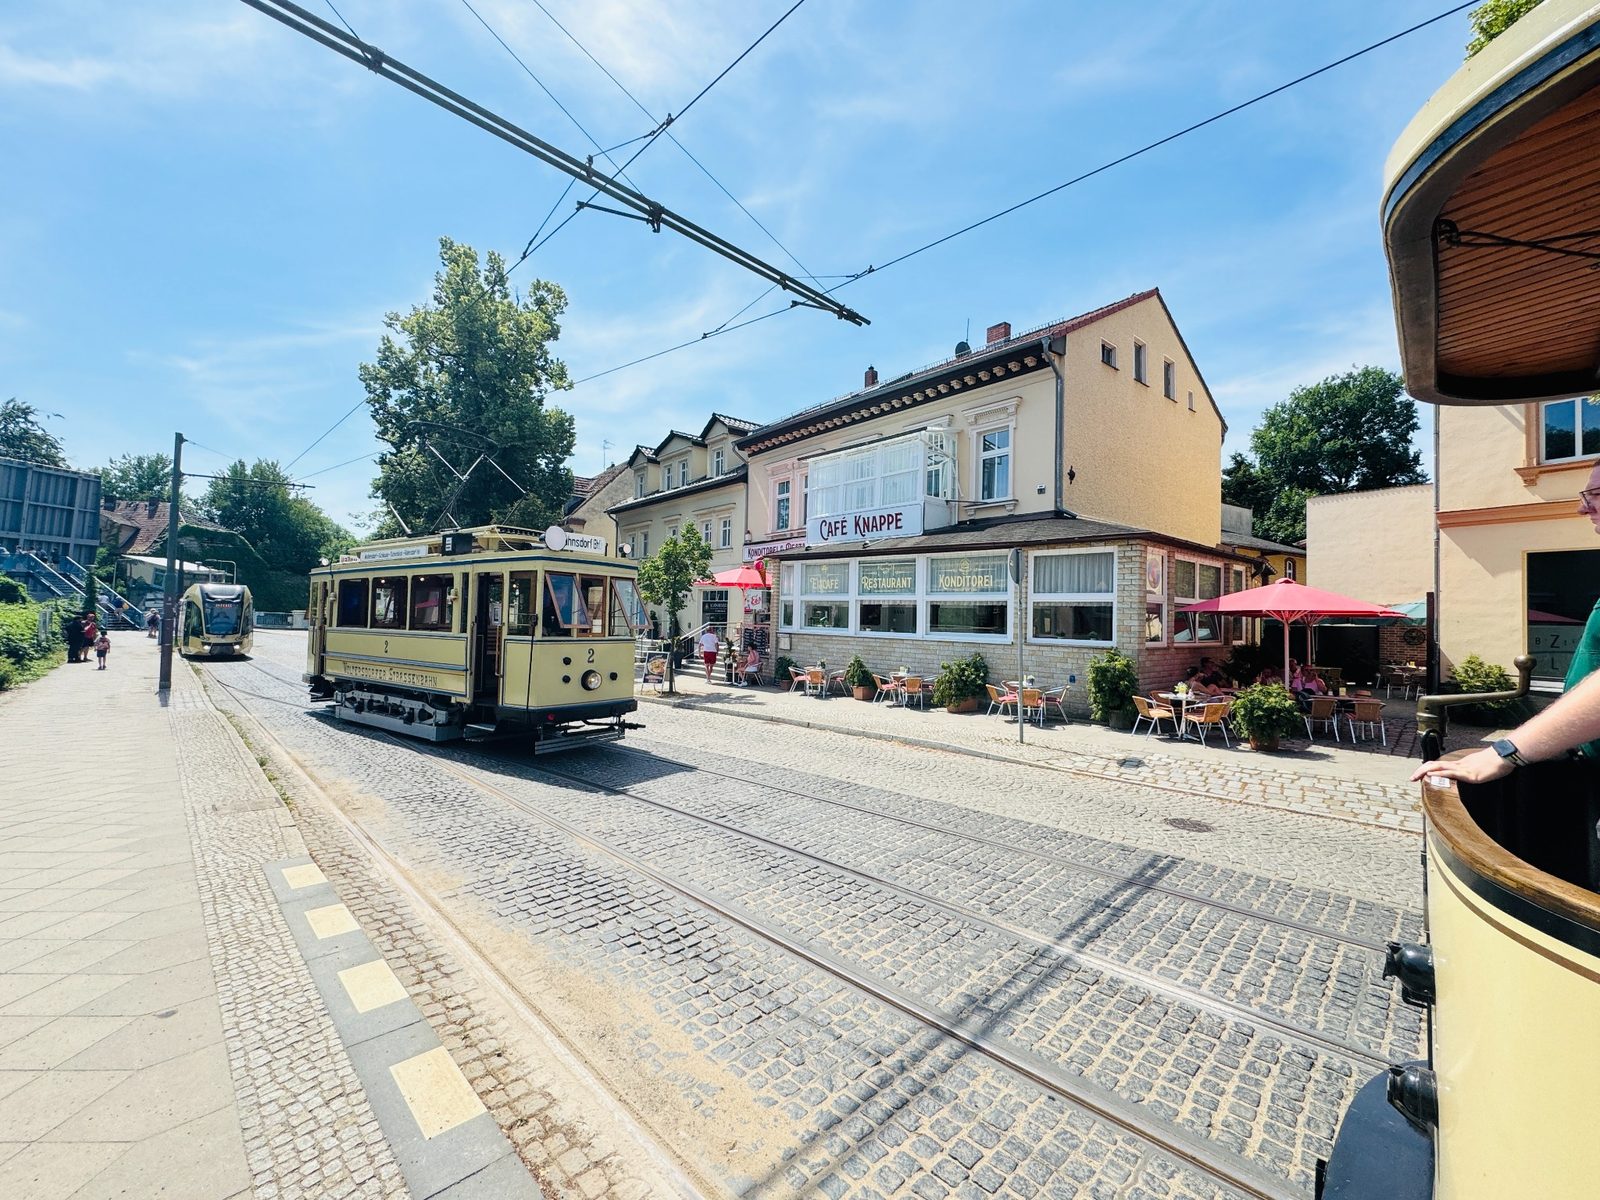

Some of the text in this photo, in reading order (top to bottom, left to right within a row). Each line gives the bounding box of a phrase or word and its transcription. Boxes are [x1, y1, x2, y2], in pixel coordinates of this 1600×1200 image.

[820, 512, 903, 541] CAFÉ KNAPPE
[567, 536, 593, 549] hnsdorf
[861, 576, 912, 590] RESTAURANT
[938, 574, 993, 590] KONDITOREI
[384, 640, 389, 653] 2
[587, 648, 595, 663] 2
